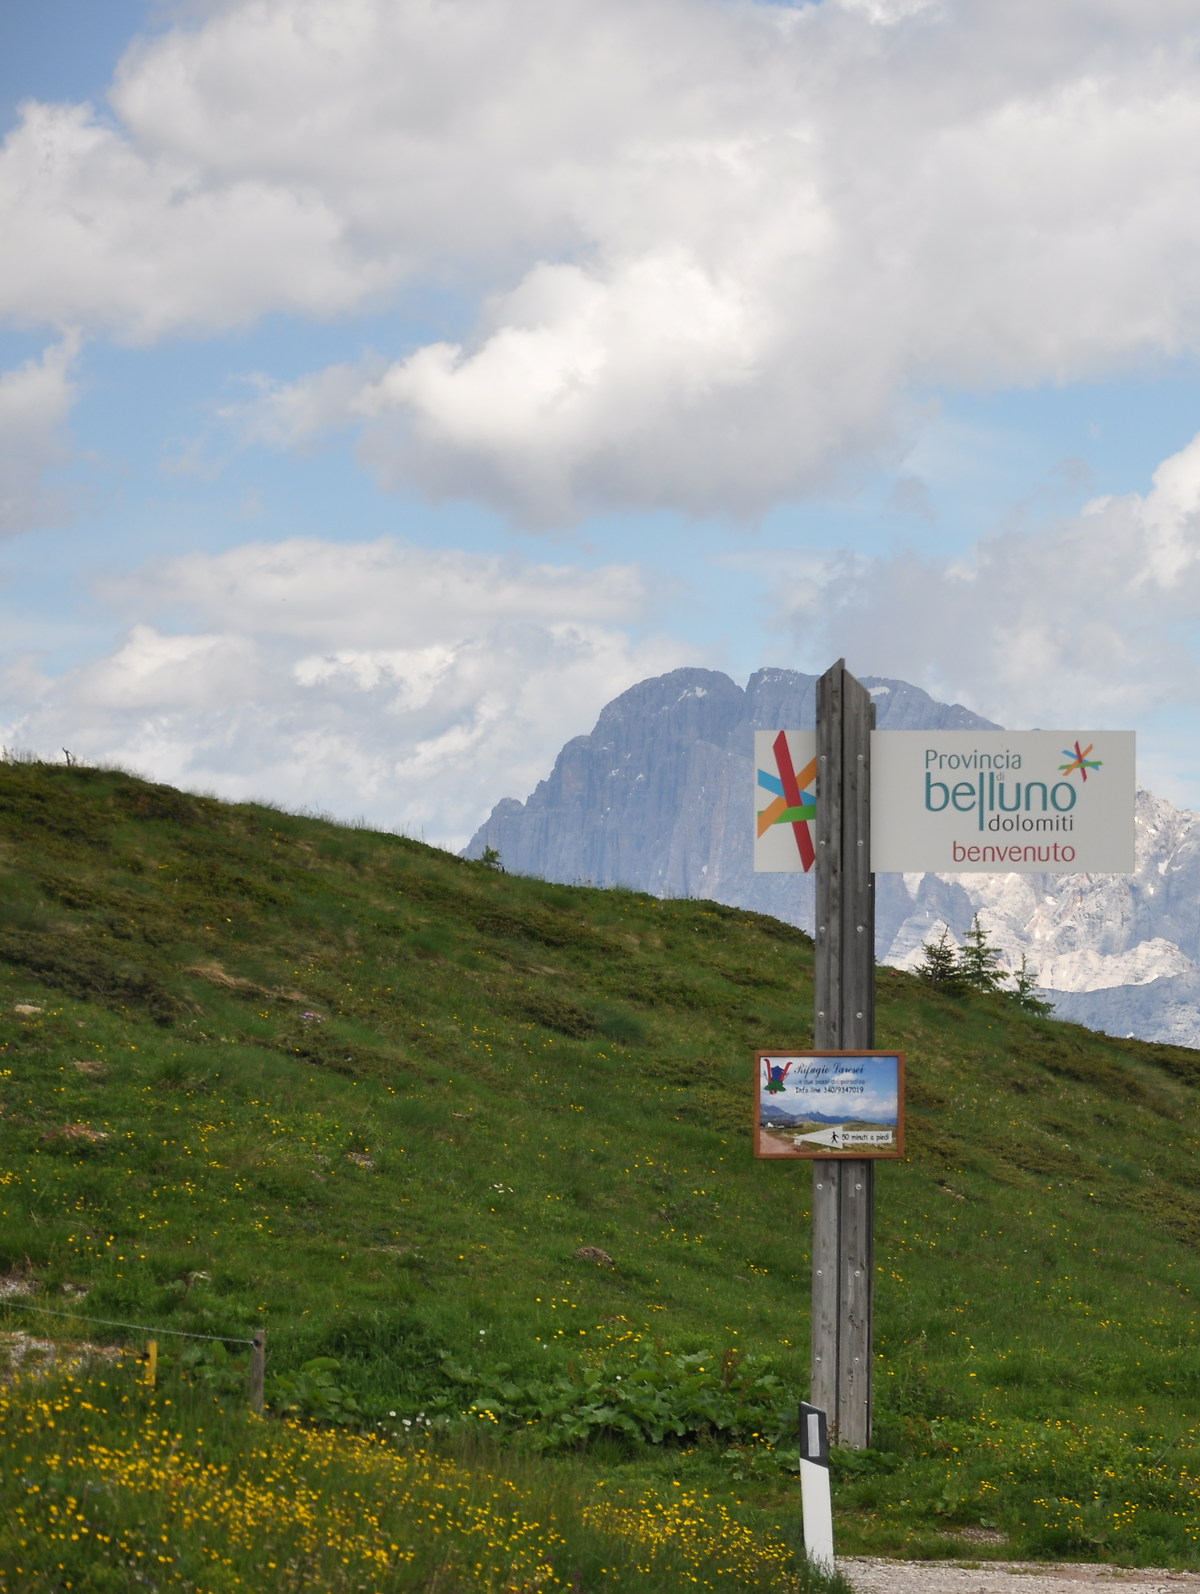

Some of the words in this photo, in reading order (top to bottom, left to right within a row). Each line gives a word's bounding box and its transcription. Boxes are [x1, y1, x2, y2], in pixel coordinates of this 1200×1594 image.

[925, 749, 1022, 769] Provincia
[996, 772, 1005, 781] di
[925, 771, 1077, 831] belluno
[988, 814, 1074, 831] dolomiti
[953, 840, 1076, 862] benvenuto
[795, 1086, 809, 1094] Info
[810, 1086, 821, 1094] line
